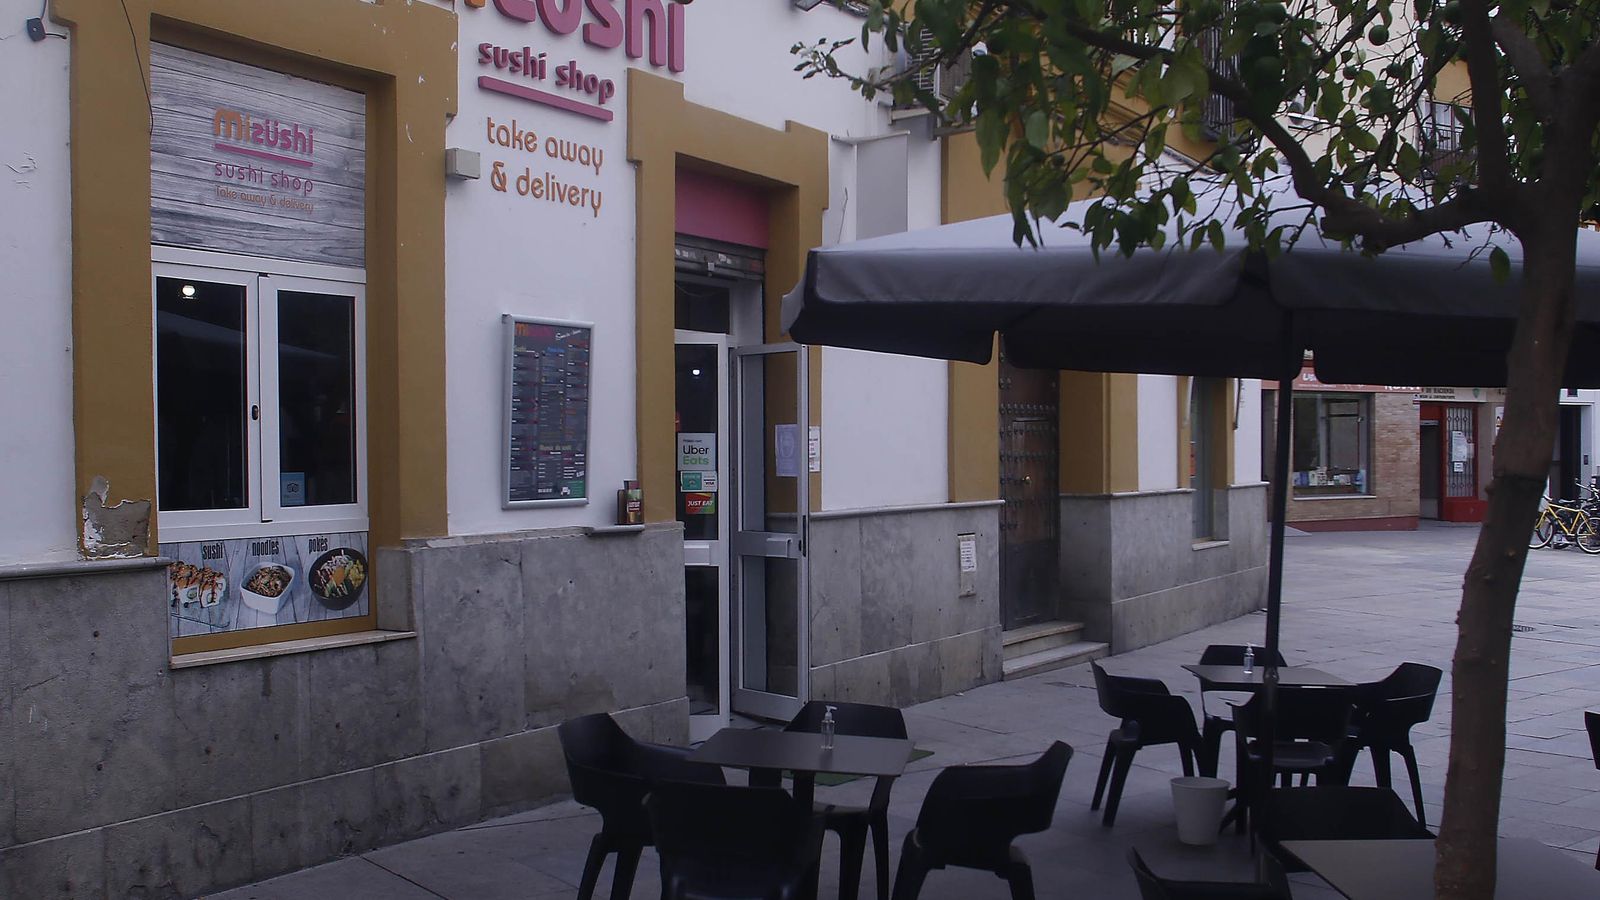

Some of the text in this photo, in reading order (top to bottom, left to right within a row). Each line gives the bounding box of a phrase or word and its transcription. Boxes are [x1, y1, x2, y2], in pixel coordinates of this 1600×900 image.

[555, 60, 615, 104] shop
[487, 117, 603, 176] take away
[214, 162, 313, 196] sushi shop
[490, 161, 602, 218] & delivery
[240, 192, 266, 206] away
[269, 194, 277, 206] &
[279, 195, 314, 214] delivery
[683, 444, 709, 455] Uber
[683, 455, 709, 466] Eats
[203, 542, 223, 560] sushi
[252, 539, 280, 557] noodles
